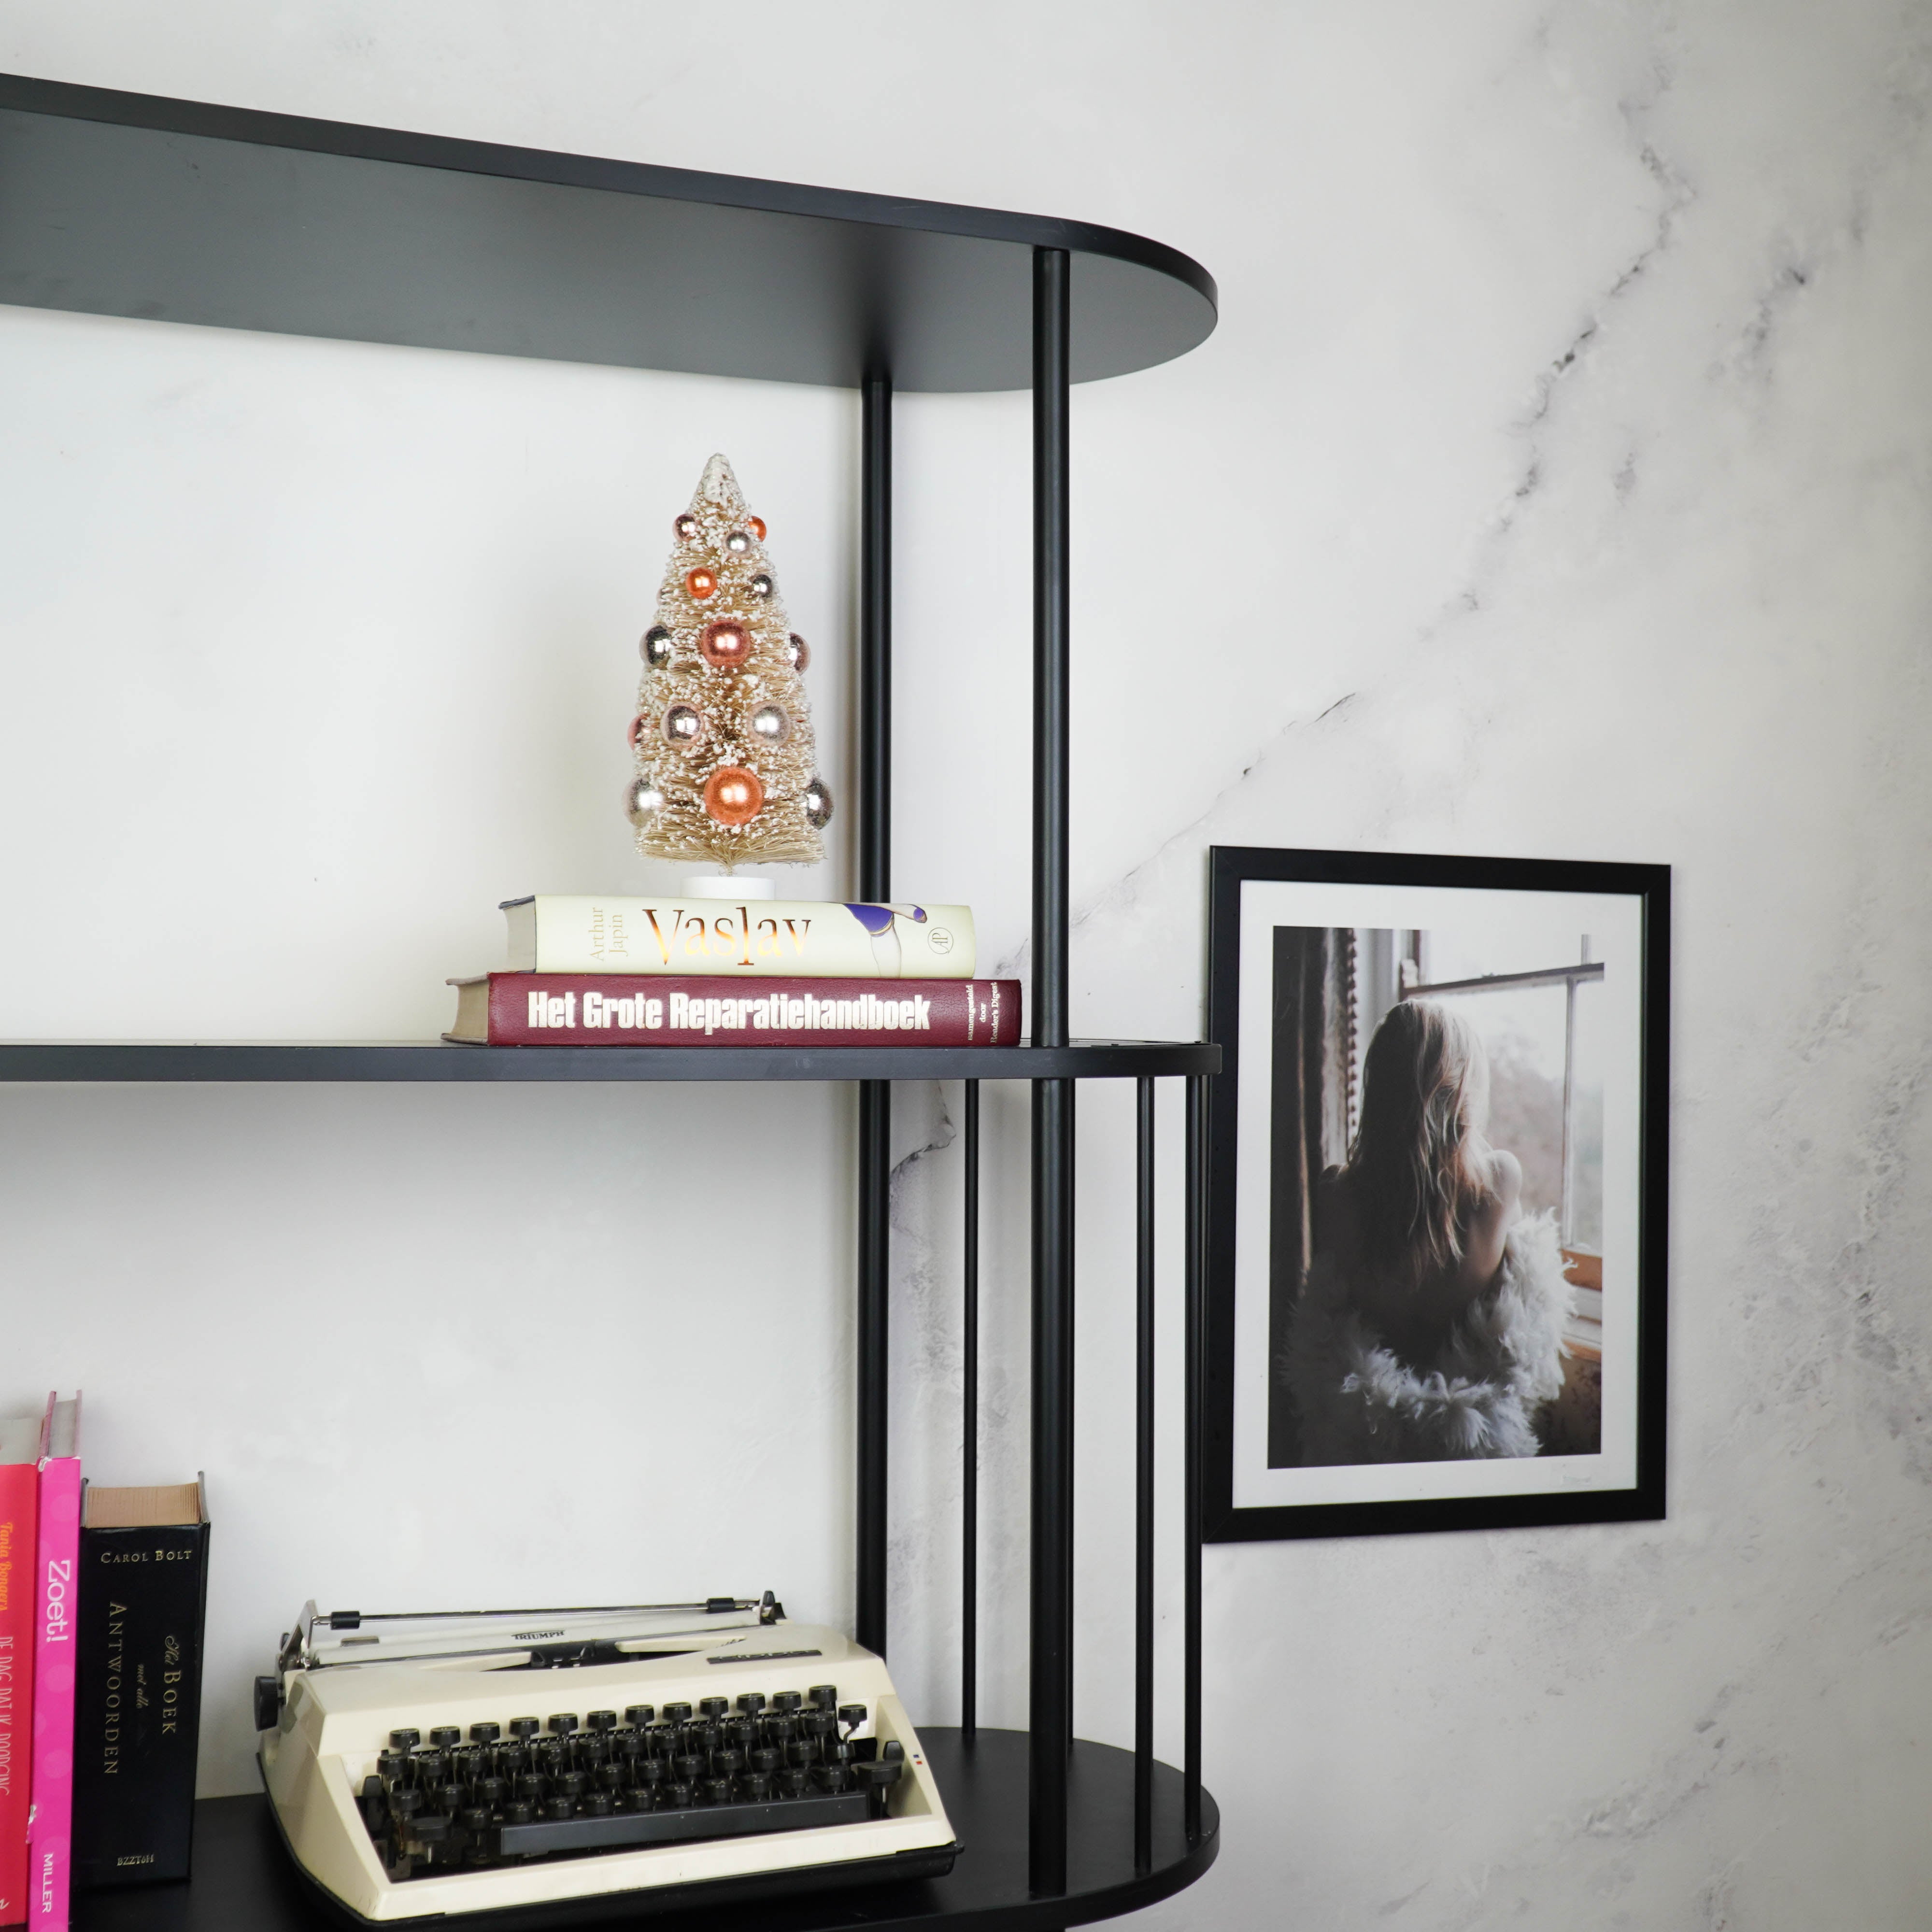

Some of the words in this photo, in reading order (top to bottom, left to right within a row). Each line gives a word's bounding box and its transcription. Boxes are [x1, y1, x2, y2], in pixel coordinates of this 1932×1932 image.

[588, 907, 604, 961] Arthur
[609, 914, 628, 957] Japin
[642, 907, 811, 966] Vaslav
[528, 992, 576, 1028] Het
[583, 992, 663, 1029] Grote
[669, 993, 931, 1036] Reparatiehandboek
[990, 981, 1000, 1008] Digest
[101, 1551, 148, 1564] CAROL
[155, 1549, 192, 1561] BOLT
[46, 1560, 71, 1642] Zoet!
[511, 1630, 565, 1640] TRIUMPH
[104, 1601, 127, 1774] ANTWOORDEN
[137, 1664, 147, 1686] met
[136, 1688, 149, 1709] alle
[162, 1670, 182, 1735] BOEK
[42, 1853, 54, 1913] MILLER
